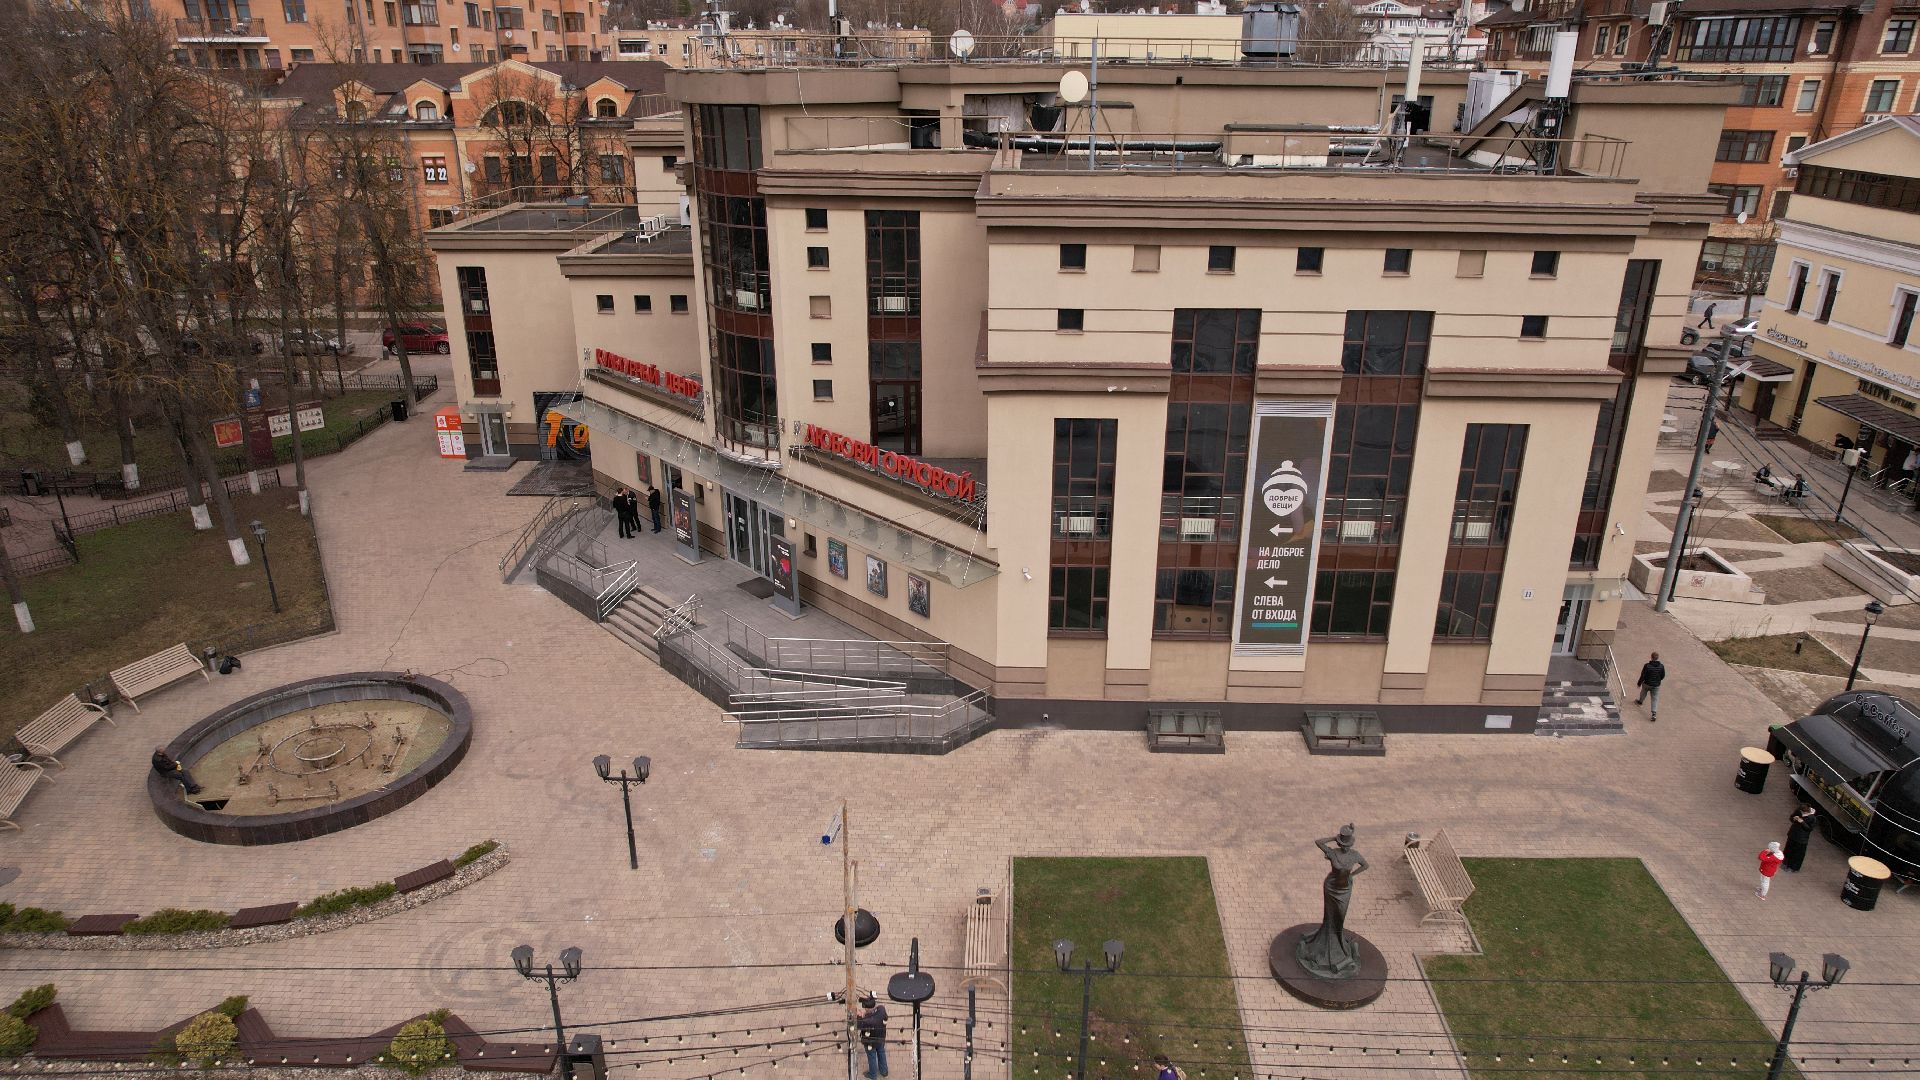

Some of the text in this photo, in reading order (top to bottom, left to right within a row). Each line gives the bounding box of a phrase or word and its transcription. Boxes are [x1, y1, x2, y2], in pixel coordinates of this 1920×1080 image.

[664, 370, 702, 399] ЦЕНТР
[804, 423, 976, 503] ЛЮБОВИ ОРЛОВОЙ
[1258, 546, 1305, 558] НА ДОБРОЕ
[1256, 559, 1281, 570] ДЕЛО
[1253, 595, 1284, 606] СЛЕВА
[1251, 609, 1297, 621] ОТ ВХОДА
